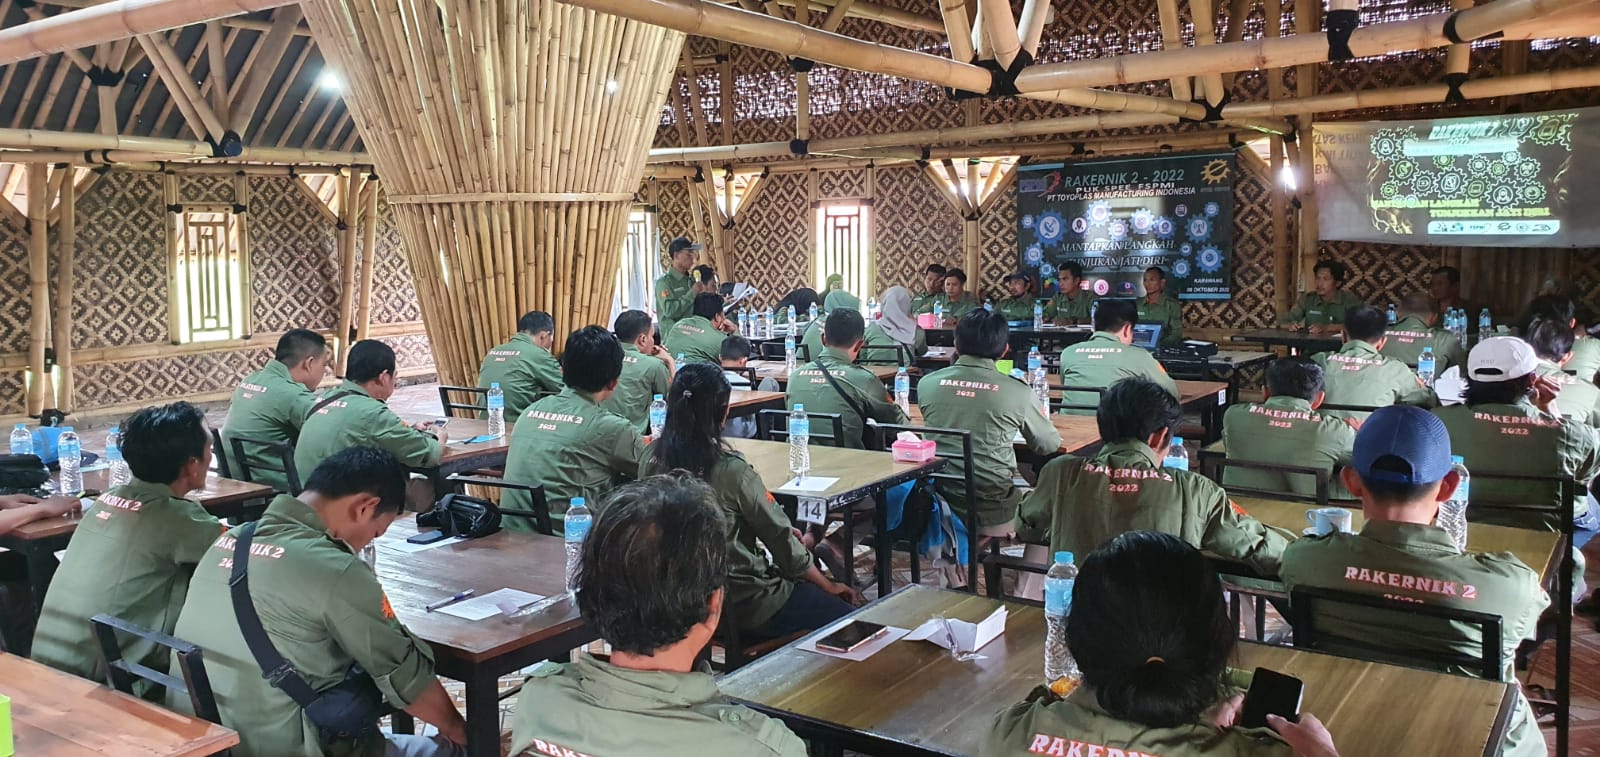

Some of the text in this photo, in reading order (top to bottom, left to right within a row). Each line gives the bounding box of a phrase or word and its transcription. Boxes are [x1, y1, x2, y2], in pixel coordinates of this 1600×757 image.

[1065, 172, 1127, 188] RAKERNIK
[1130, 171, 1138, 184] 2
[1152, 169, 1185, 182] 2022
[1104, 184, 1131, 192] SPEE
[1047, 194, 1057, 202] PT
[1057, 192, 1092, 201] TOYOPLAS
[1093, 189, 1155, 200] MANUFACTURING
[1155, 187, 1196, 196] INDONESIA
[1062, 240, 1174, 252] MANTAPKAN LANGKAH
[1120, 257, 1142, 267] JATI
[1142, 256, 1165, 265] DIRI
[940, 379, 990, 390] RAKERNIK
[955, 390, 976, 398] 2022
[526, 410, 584, 425] RAKERNIK 2
[1248, 405, 1321, 422] RAKERNIK 2
[1474, 412, 1547, 427] RAKERNIK
[537, 423, 557, 431] 2022
[1268, 420, 1292, 428] 2022
[1500, 426, 1529, 435] 2022
[1084, 463, 1173, 482] RAKERNIK 2
[1108, 483, 1139, 492] 2022
[128, 500, 143, 512] 2
[801, 500, 822, 520] 14
[271, 545, 285, 560] 2
[1344, 565, 1478, 600] RAKERNIK 2
